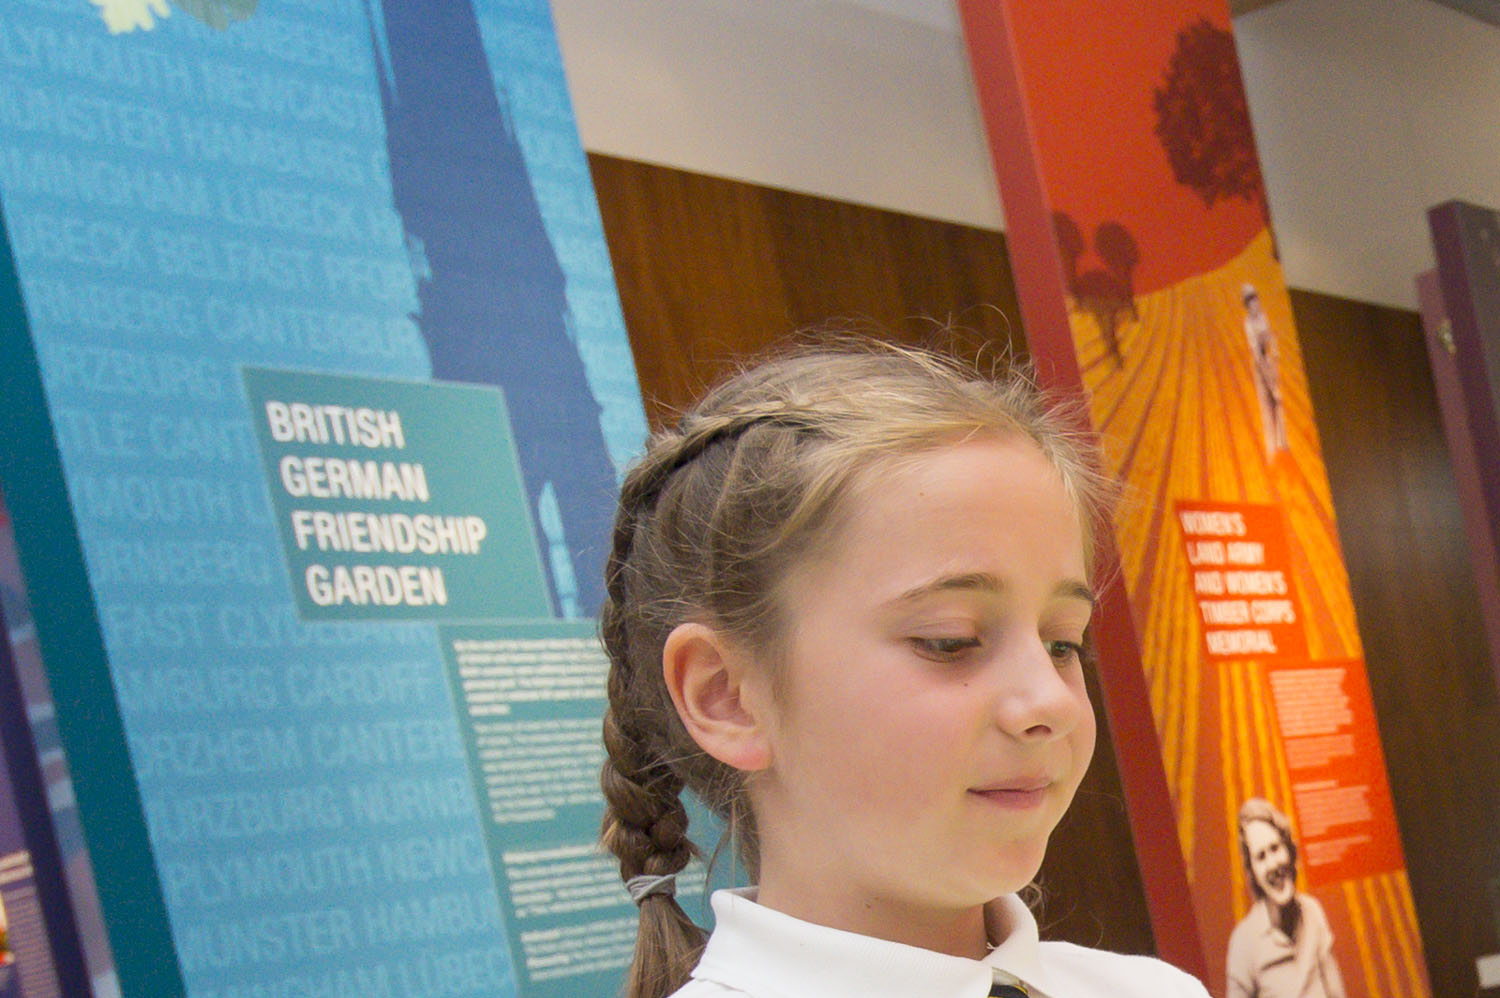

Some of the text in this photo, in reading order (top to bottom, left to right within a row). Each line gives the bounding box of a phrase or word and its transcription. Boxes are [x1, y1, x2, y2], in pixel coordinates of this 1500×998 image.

[265, 400, 404, 450] BRITISH
[280, 455, 429, 502] GERMAN
[292, 510, 487, 554] FRIENDSHIP
[305, 565, 448, 607] GARDEN
